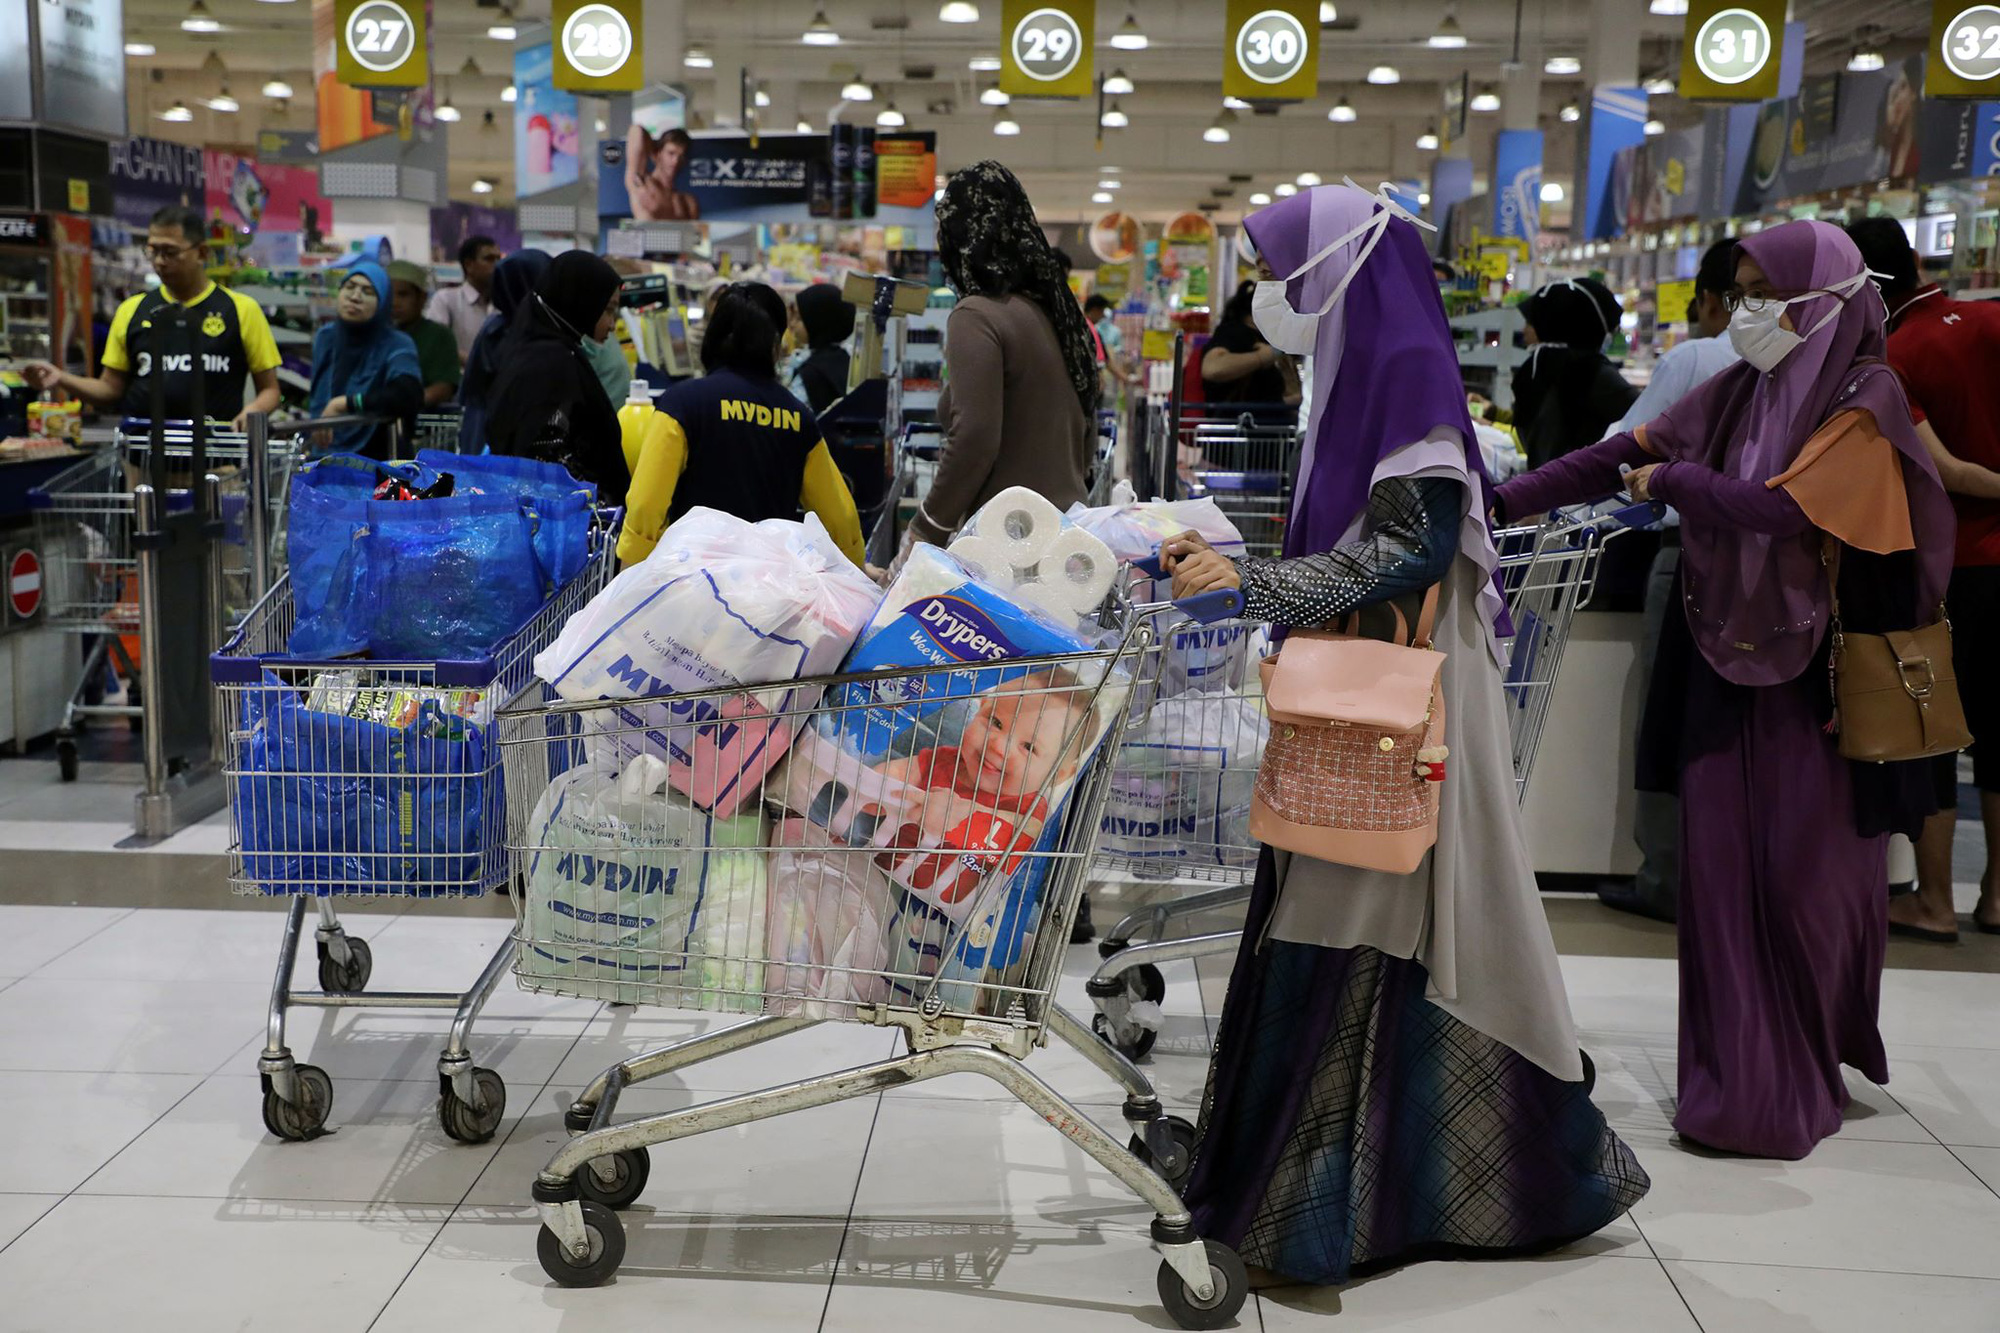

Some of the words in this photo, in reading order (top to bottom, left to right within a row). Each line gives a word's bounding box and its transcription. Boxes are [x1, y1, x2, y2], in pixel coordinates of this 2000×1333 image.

[355, 19, 405, 53] 27
[573, 23, 622, 57] 28
[1022, 28, 1073, 62] 29
[1246, 30, 1298, 65] 30
[1708, 28, 1759, 65] 31
[1953, 25, 2000, 60] 32
[183, 148, 235, 195] RAMB
[720, 399, 800, 432] MYDIN
[909, 630, 931, 656] Wee
[920, 599, 1007, 661] Drypers
[1176, 626, 1248, 650] MYDI
[606, 653, 740, 750] MYDIN
[983, 820, 1002, 850] L
[1100, 815, 1196, 838] MYDIN
[556, 851, 679, 895] MYDIN
